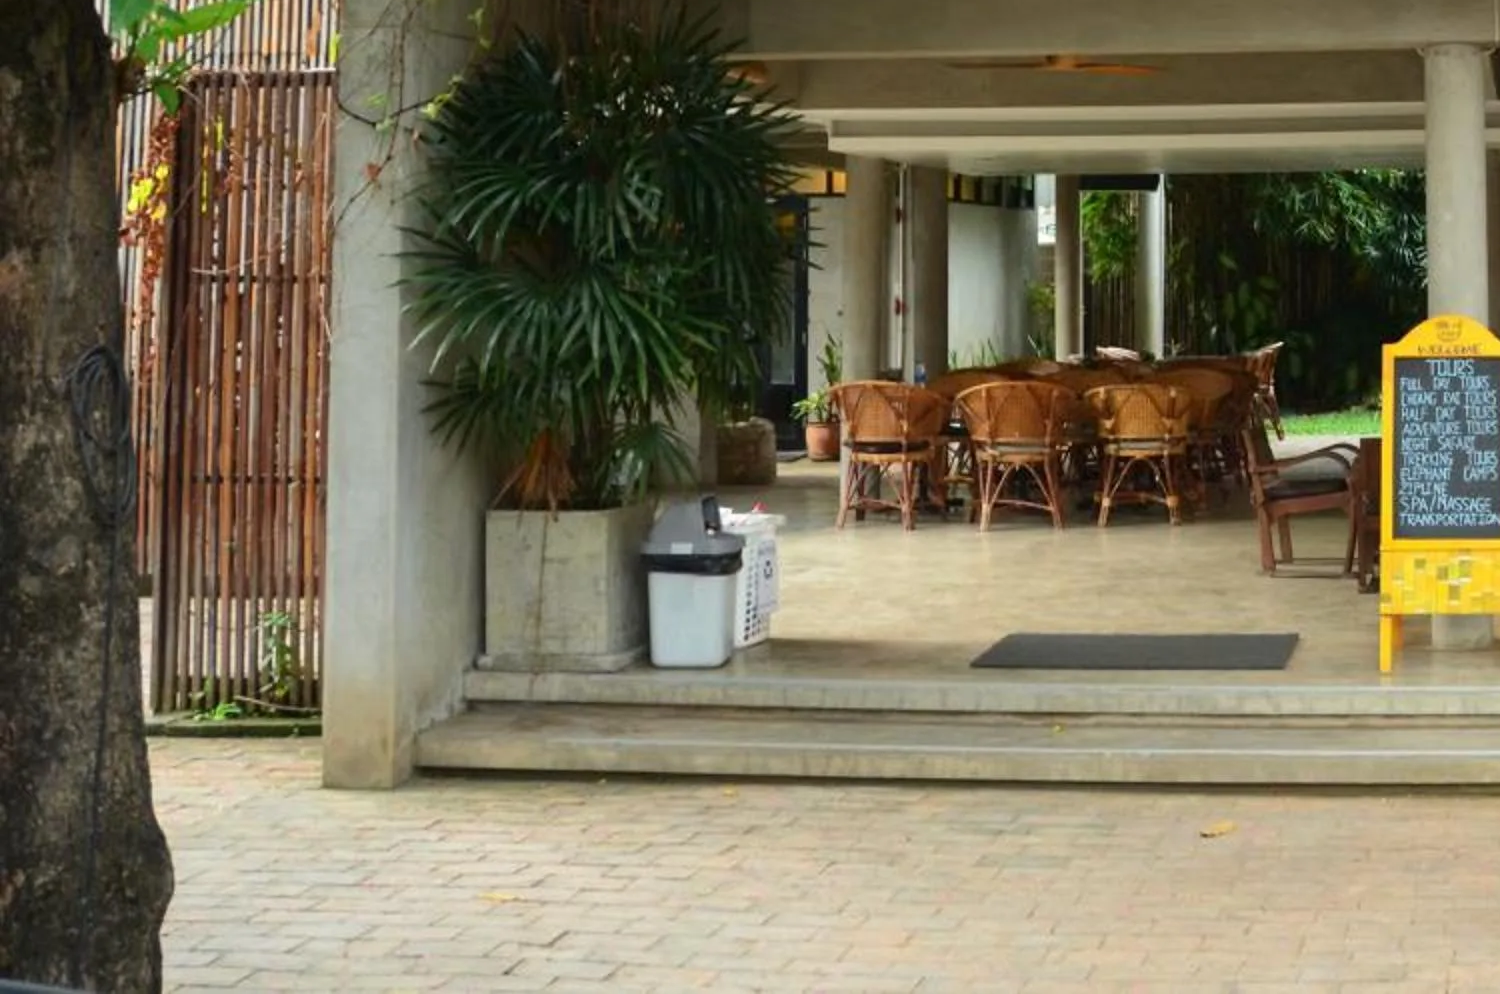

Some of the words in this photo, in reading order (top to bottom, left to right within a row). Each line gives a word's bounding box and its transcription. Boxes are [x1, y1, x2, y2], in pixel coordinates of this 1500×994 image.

[1425, 359, 1475, 377] TOURS
[1399, 377, 1422, 391] FULL
[1433, 377, 1451, 391] DAY
[1460, 375, 1491, 391] TOURS
[1464, 389, 1498, 406] TOURS
[1401, 406, 1430, 422] HALF
[1435, 406, 1456, 421] DAY
[1464, 406, 1498, 420] TOURS
[1403, 421, 1462, 436] ADVENTURE
[1466, 420, 1498, 435] TOURS
[1401, 437, 1431, 451] NIGHT
[1437, 435, 1477, 451] SAFARI
[1400, 451, 1453, 466] TREKKING
[1465, 449, 1498, 466] TOURS
[1400, 467, 1451, 481] ELEPHANT
[1463, 466, 1498, 482] CAMPS
[1398, 481, 1449, 497] ZIPLINE
